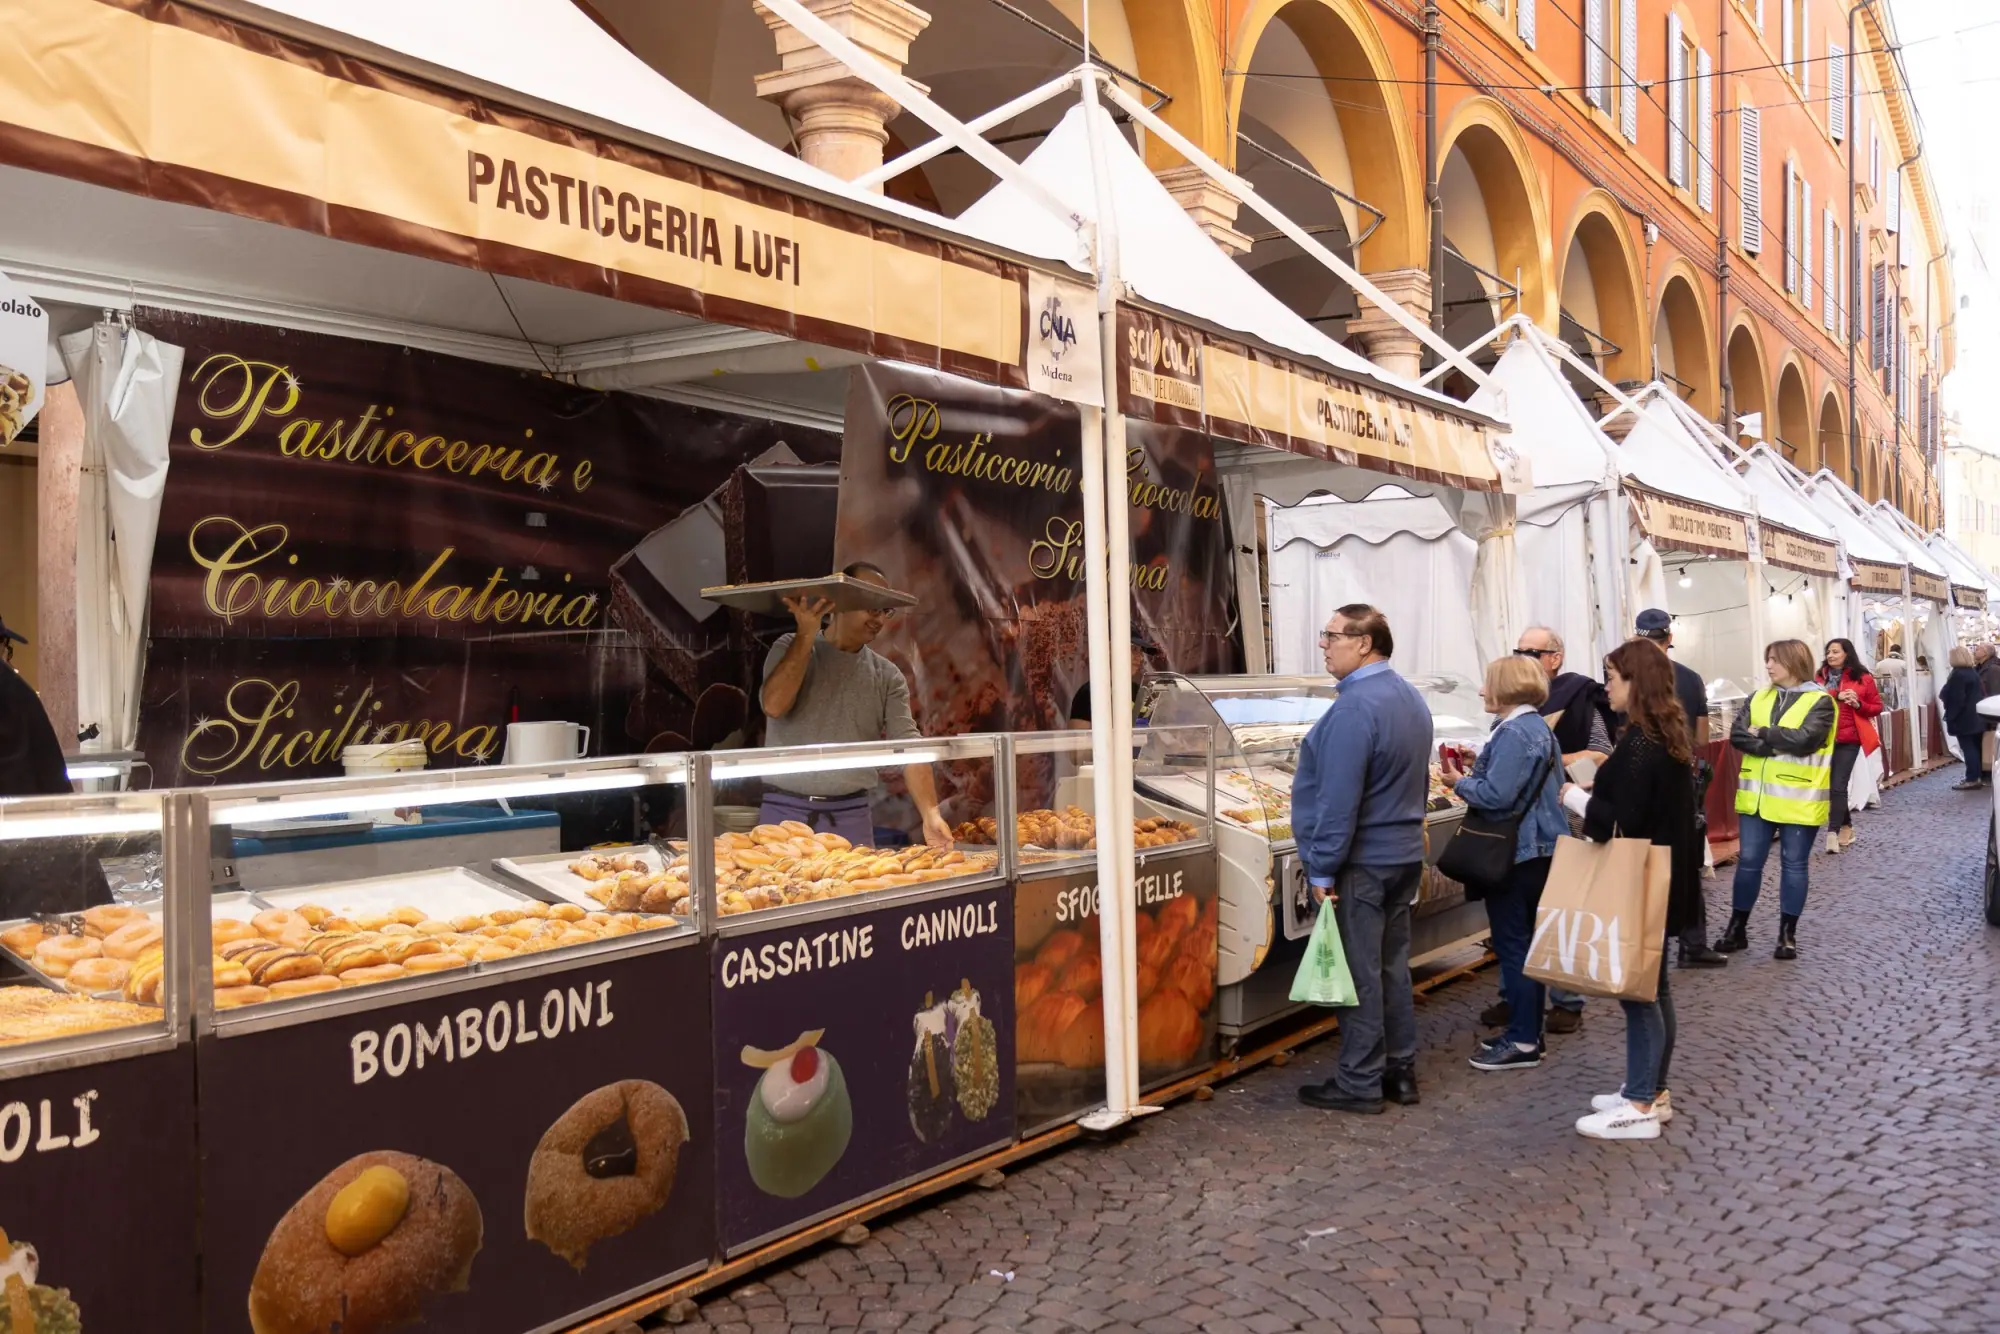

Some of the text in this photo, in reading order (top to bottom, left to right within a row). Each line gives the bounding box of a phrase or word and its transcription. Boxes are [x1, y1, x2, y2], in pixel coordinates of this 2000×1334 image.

[468, 149, 801, 286] PASTICCERIA LUFI
[0, 299, 42, 318] olato
[1040, 310, 1077, 345] CNA
[189, 353, 592, 492] Pasticceria e
[1155, 378, 1168, 399] DEL
[886, 393, 1073, 493] Pasticceria
[189, 515, 598, 627] Cioccolateria
[901, 900, 998, 950] CANNOLI
[1056, 870, 1183, 921] SFOGTELLE
[721, 924, 874, 988] CASSATINE
[1524, 906, 1622, 985] ZARA
[350, 980, 614, 1084] BOMBOLONI
